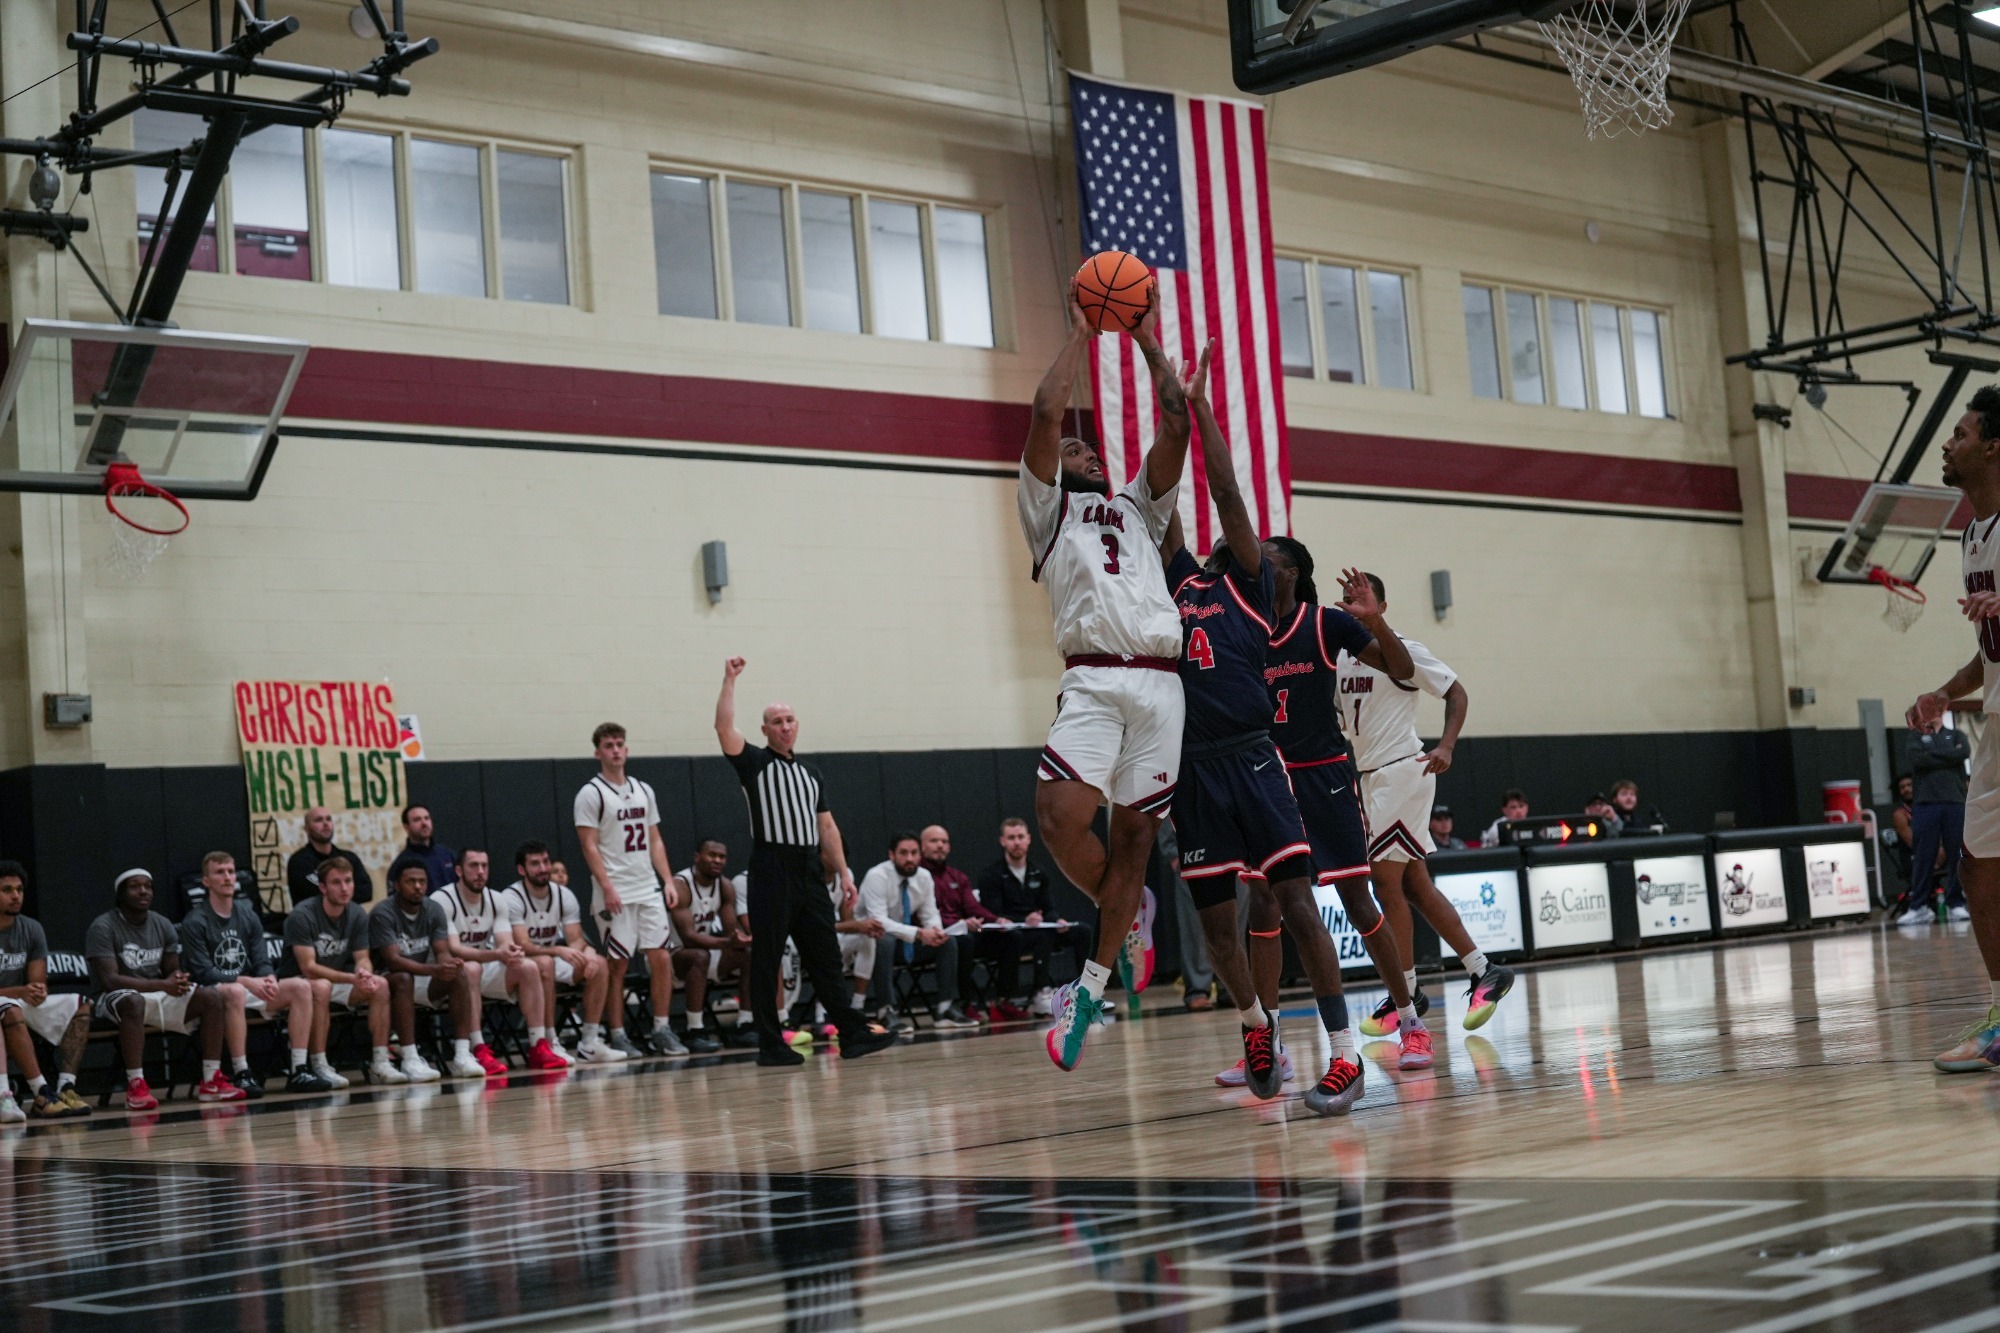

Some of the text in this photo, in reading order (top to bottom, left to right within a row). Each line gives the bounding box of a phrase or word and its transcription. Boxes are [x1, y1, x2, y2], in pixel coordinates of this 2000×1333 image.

[1101, 534, 1120, 575] 3
[1187, 626, 1216, 670] 4
[1263, 661, 1315, 686] eystone
[1340, 676, 1375, 694] CAIRN
[236, 681, 399, 750] CHRISTMAS
[1273, 688, 1289, 724] 1
[1353, 698, 1362, 736] 1
[245, 748, 402, 814] WISH-LIST
[617, 807, 646, 821] CAIRN
[624, 823, 647, 853] 22
[1183, 848, 1206, 865] KC
[1562, 887, 1606, 912] Cairn
[1340, 936, 1366, 960] EAS
[47, 953, 89, 977] AIRN
